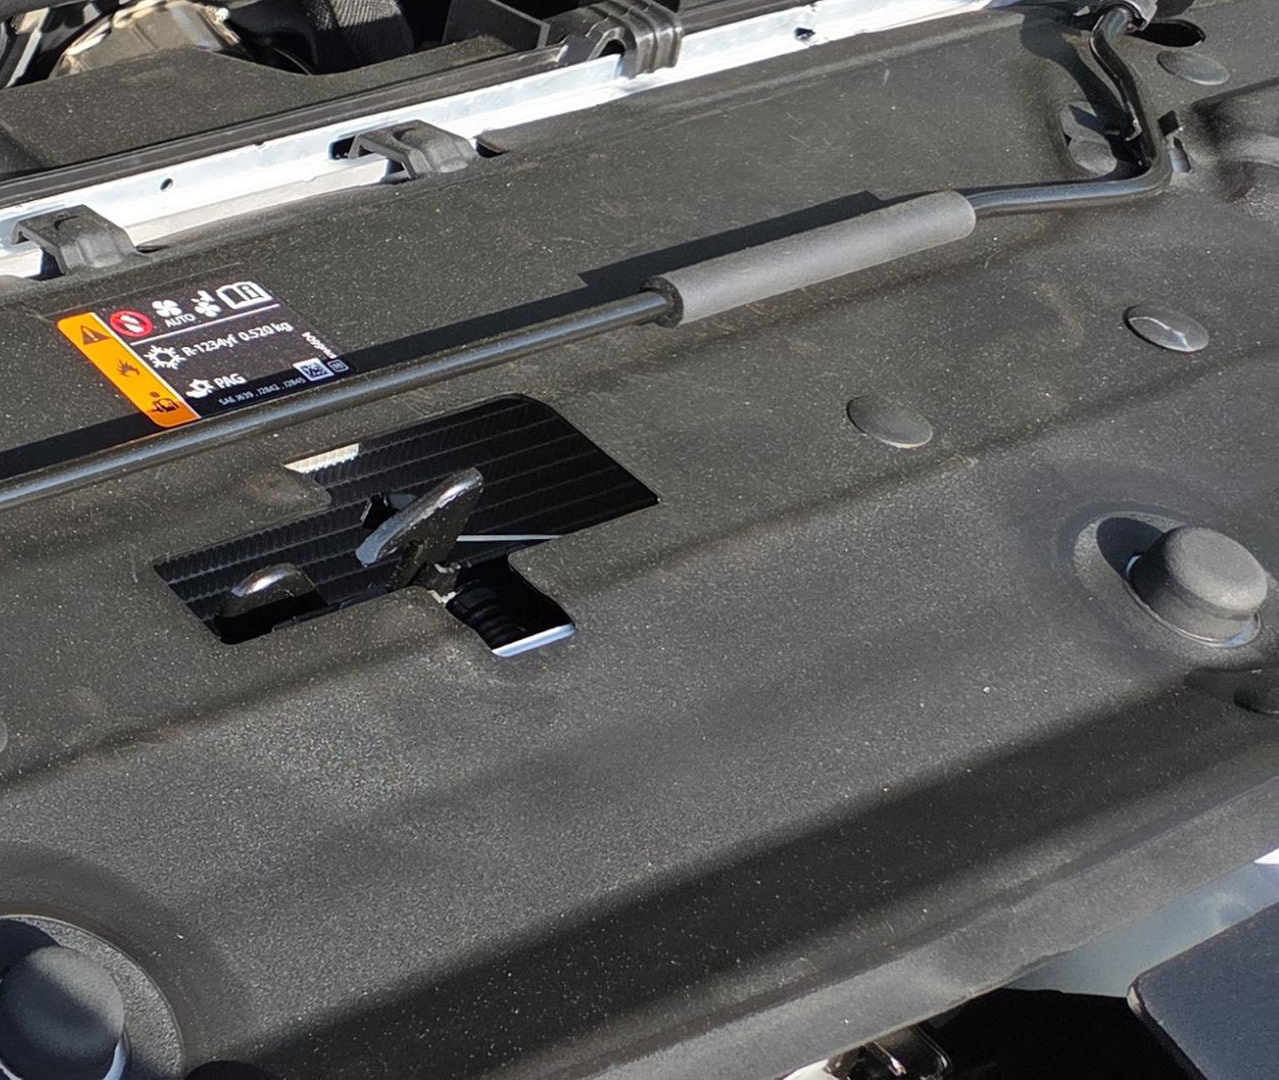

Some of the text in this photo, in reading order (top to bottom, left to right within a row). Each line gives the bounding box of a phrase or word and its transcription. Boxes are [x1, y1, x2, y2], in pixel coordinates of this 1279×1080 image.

[164, 313, 197, 328] AUTO
[181, 321, 295, 358] R-1234yf 0.520 kg
[213, 373, 247, 389] PAG
